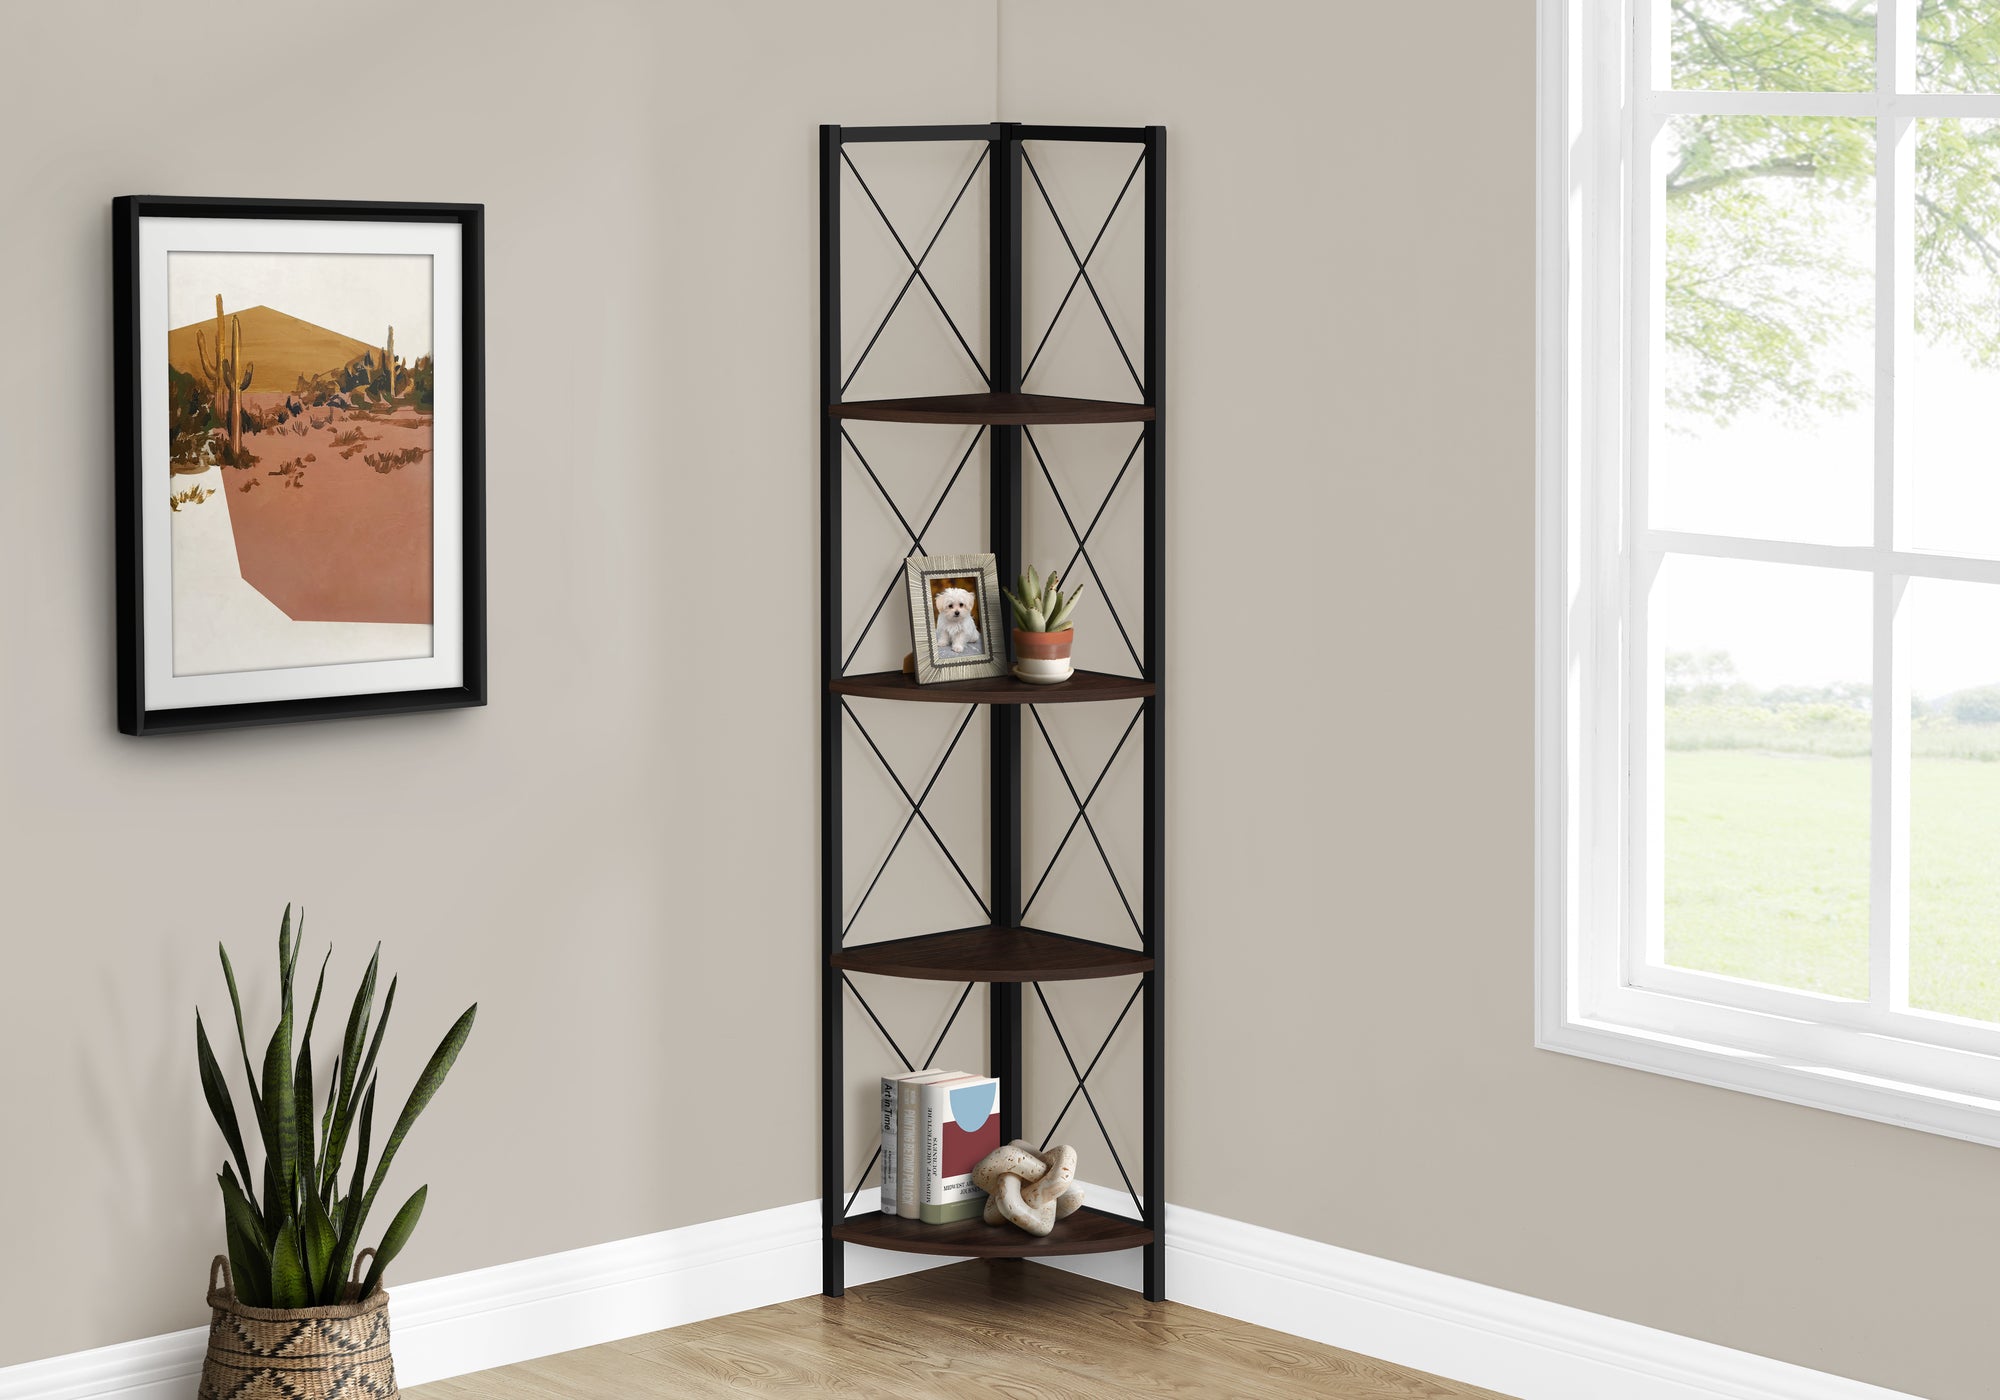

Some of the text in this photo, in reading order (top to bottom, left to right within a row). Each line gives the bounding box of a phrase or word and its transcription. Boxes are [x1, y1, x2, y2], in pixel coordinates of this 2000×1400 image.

[884, 1083, 893, 1130] Art in Time
[903, 1143, 915, 1173] BEYOND
